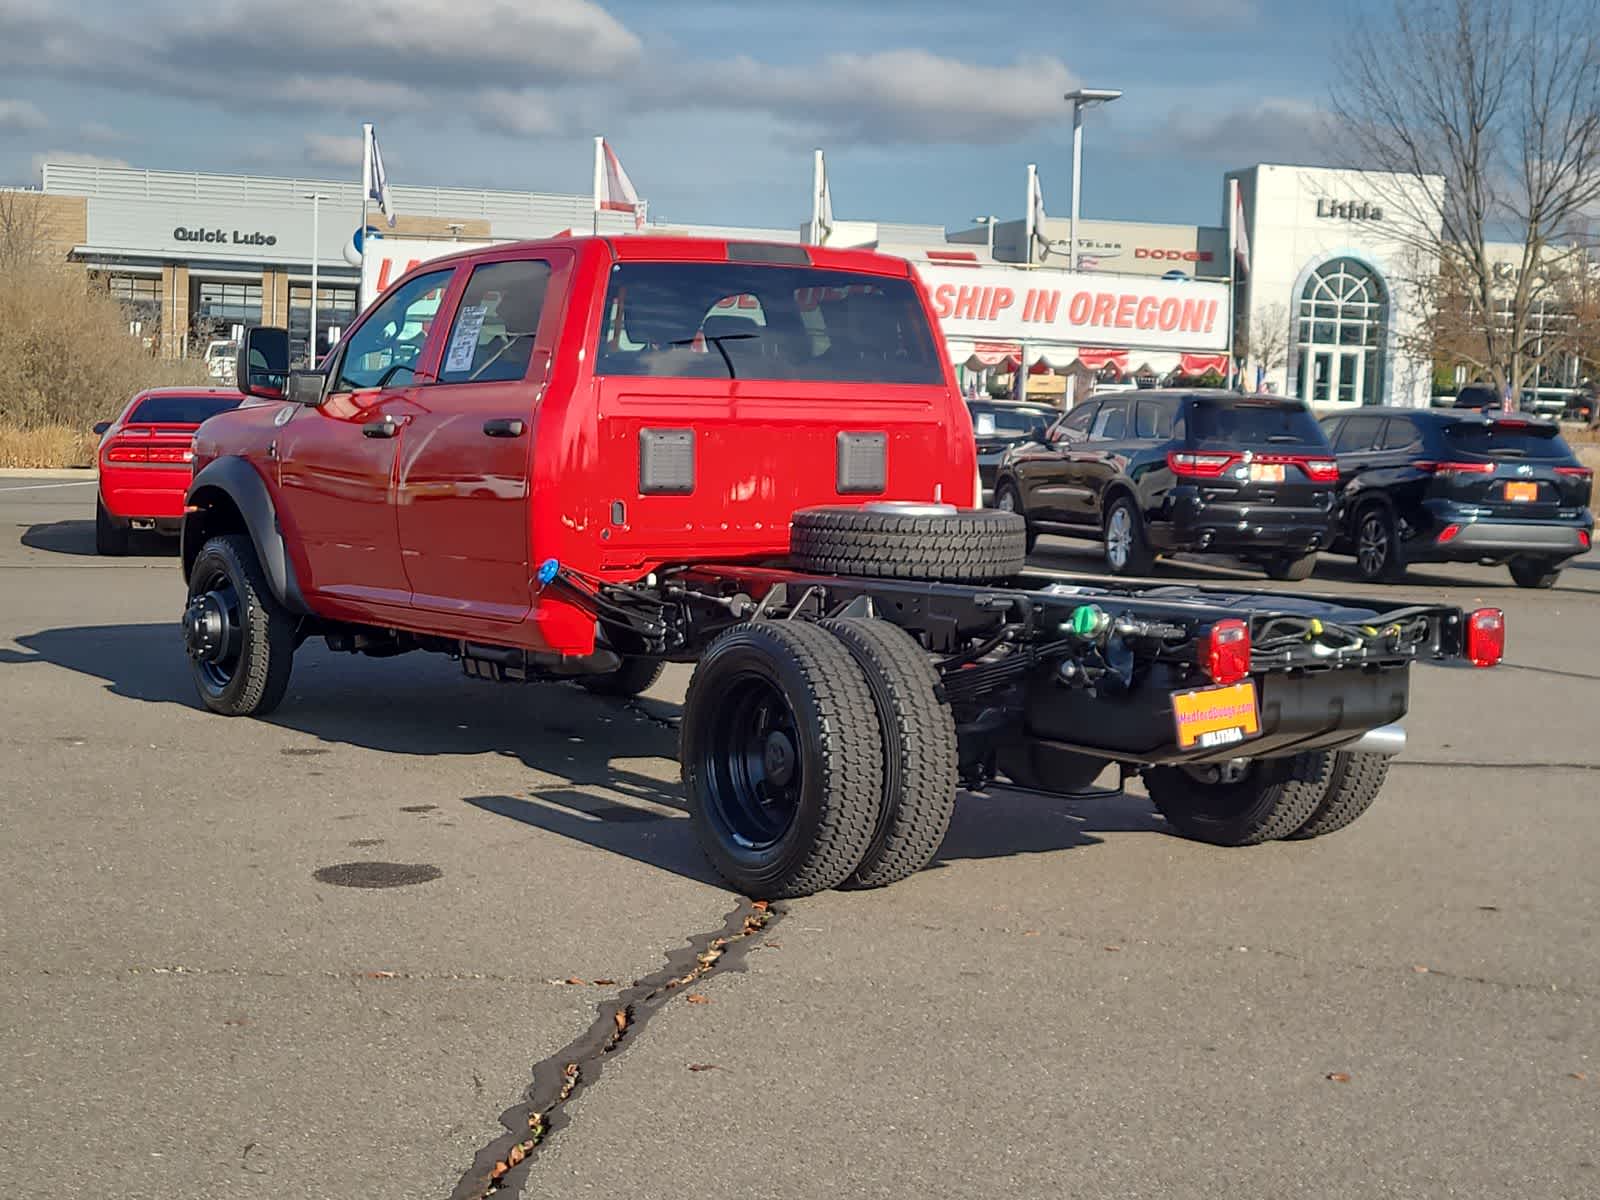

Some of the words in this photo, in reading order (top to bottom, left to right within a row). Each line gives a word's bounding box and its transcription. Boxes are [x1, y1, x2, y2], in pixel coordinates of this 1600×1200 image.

[1317, 199, 1383, 219] Lithia
[173, 226, 228, 243] Quick
[233, 230, 277, 246] Lube
[1134, 248, 1214, 262] DODGE
[926, 284, 1015, 321] SHIP
[1022, 288, 1063, 323] IN
[1068, 291, 1219, 333] OREGON!
